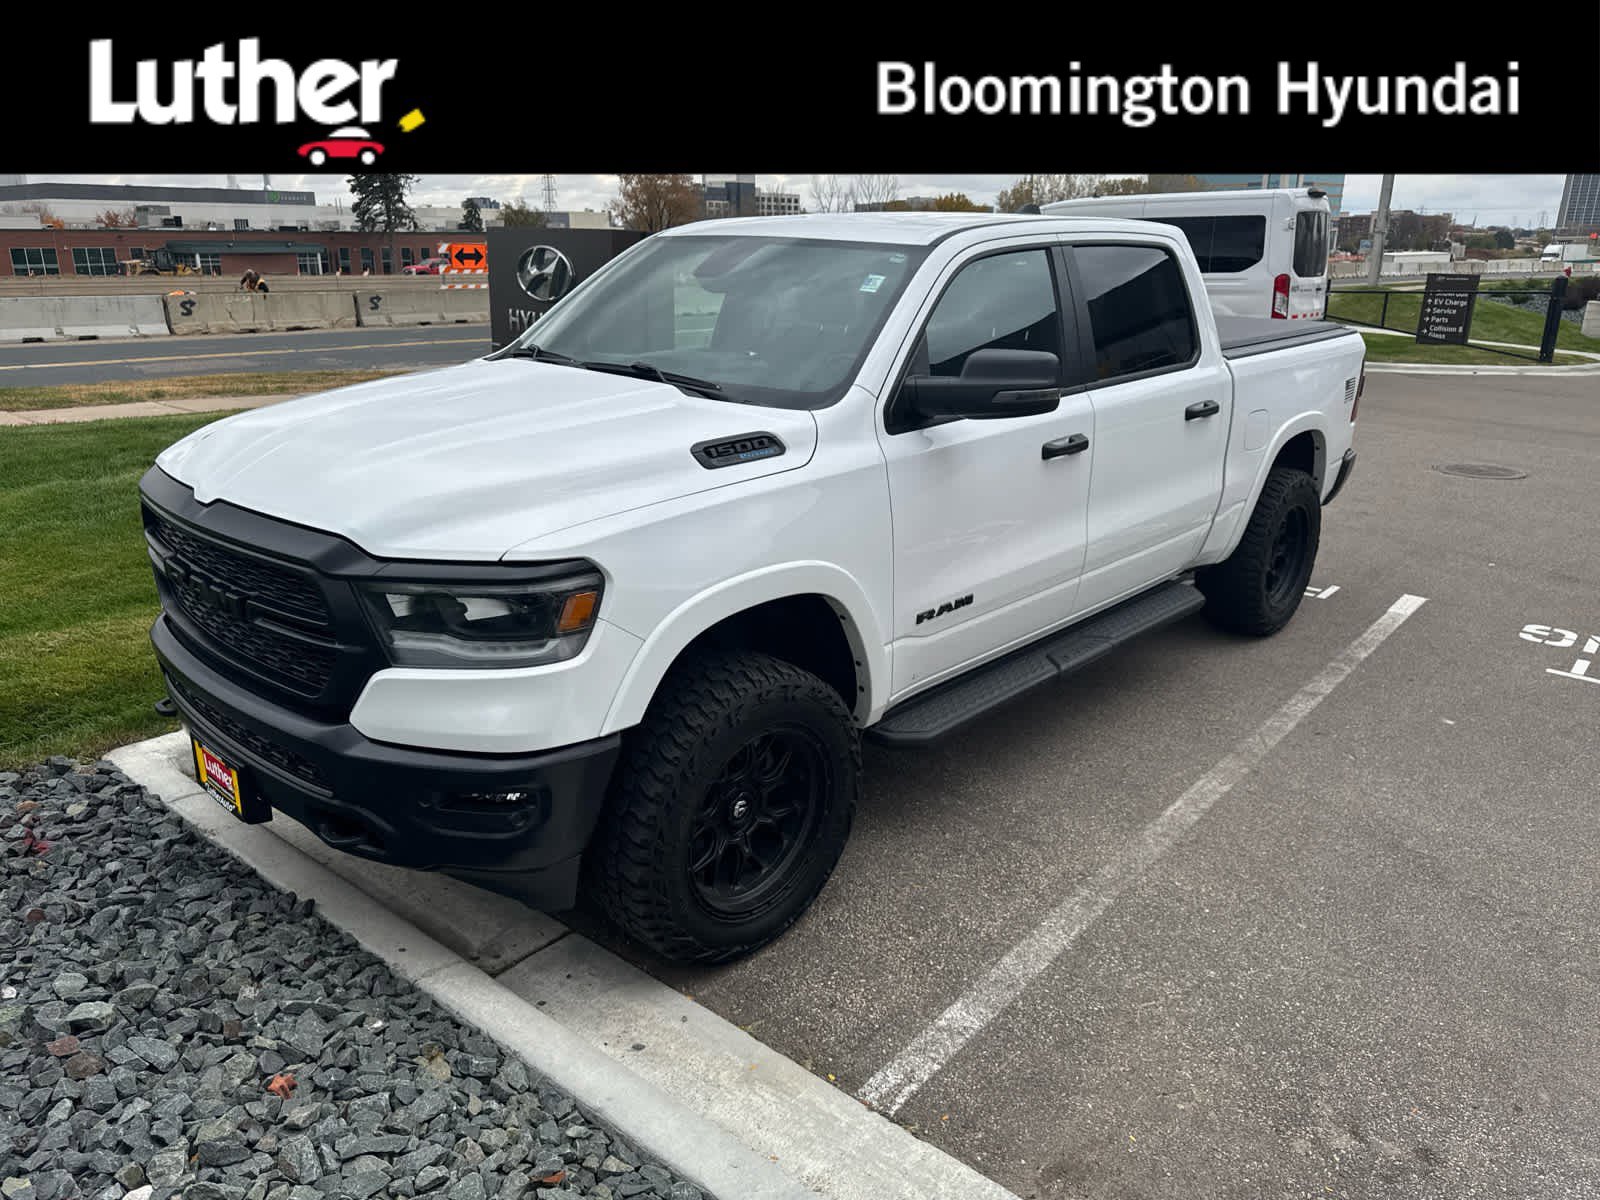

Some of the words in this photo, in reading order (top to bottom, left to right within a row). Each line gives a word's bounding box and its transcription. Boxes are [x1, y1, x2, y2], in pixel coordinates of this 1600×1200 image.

[1445, 298, 1468, 308] Charge
[1432, 307, 1457, 315] Service
[1429, 324, 1457, 333] Collision
[706, 438, 770, 459] 1500
[915, 593, 974, 624] RAM
[204, 752, 235, 788] Luther
